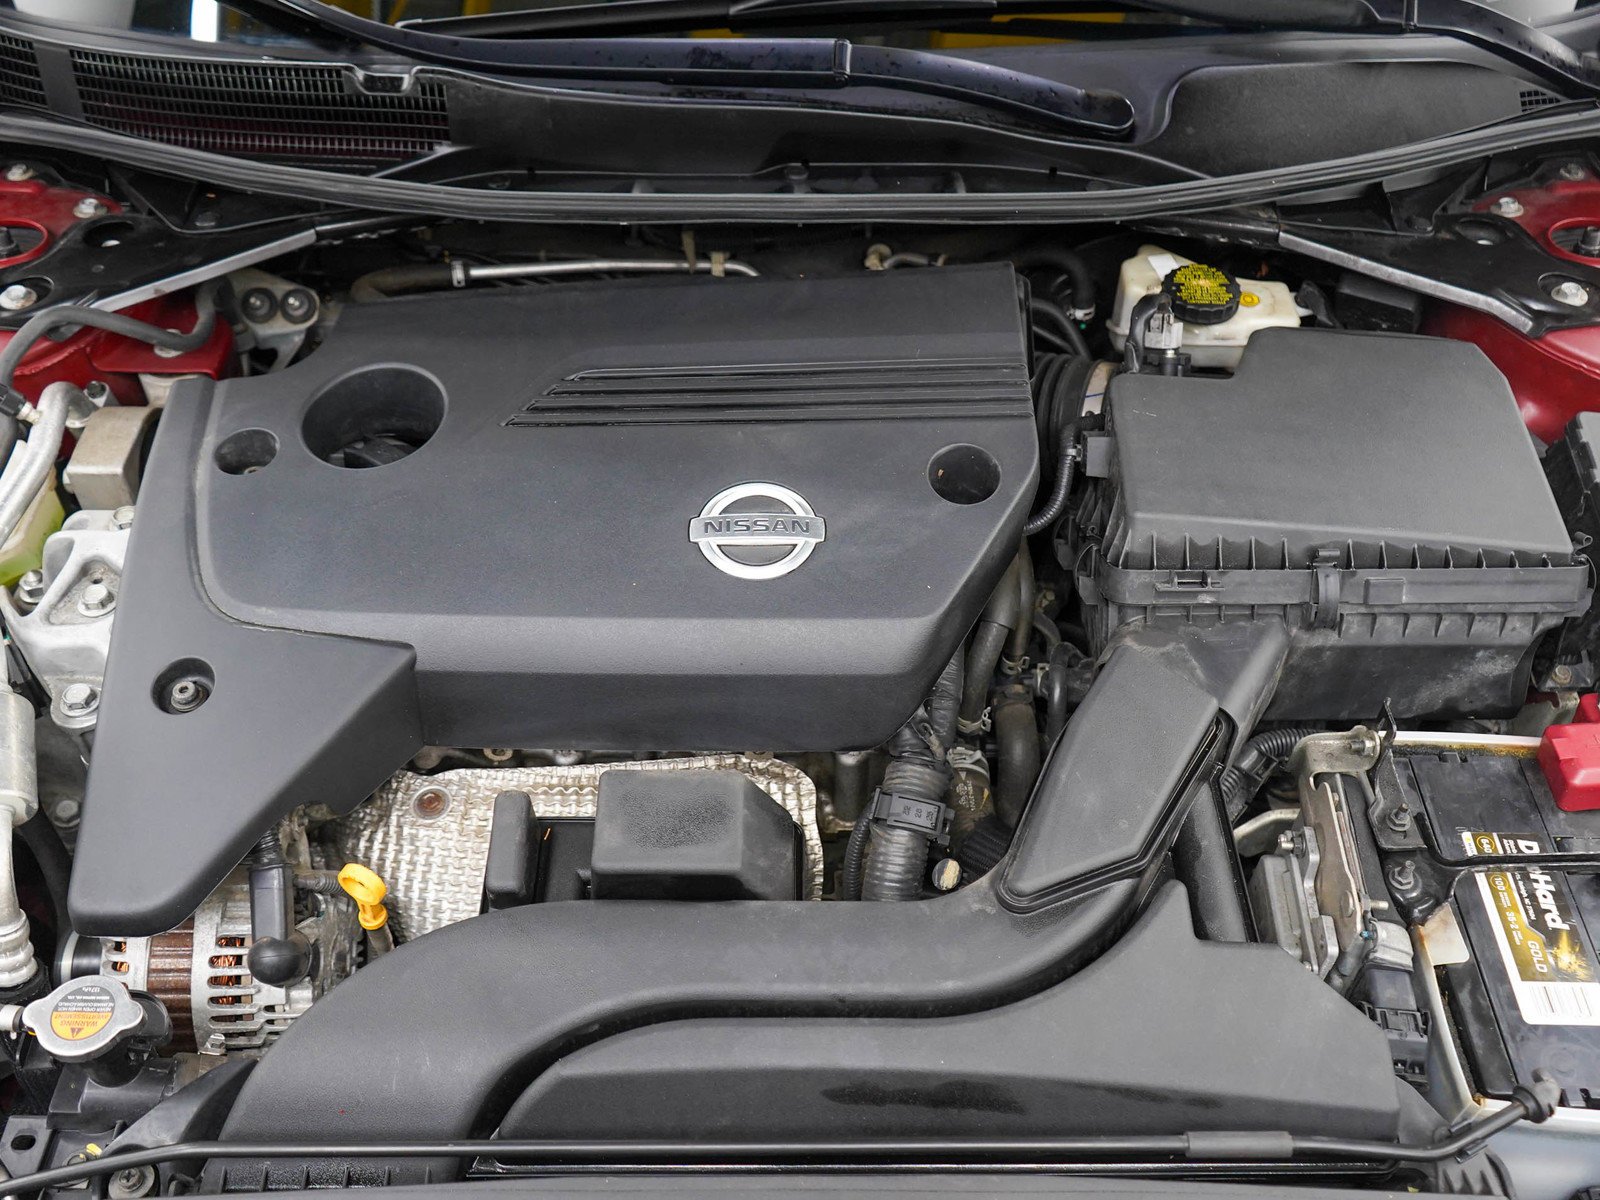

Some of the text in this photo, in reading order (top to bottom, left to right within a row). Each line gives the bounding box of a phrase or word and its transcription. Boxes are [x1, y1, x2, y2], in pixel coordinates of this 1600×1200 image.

[704, 519, 810, 534] NISSAN
[1480, 838, 1493, 854] 640
[1494, 877, 1506, 891] 100
[1517, 839, 1571, 931] DHard
[1528, 940, 1548, 973] GOLD
